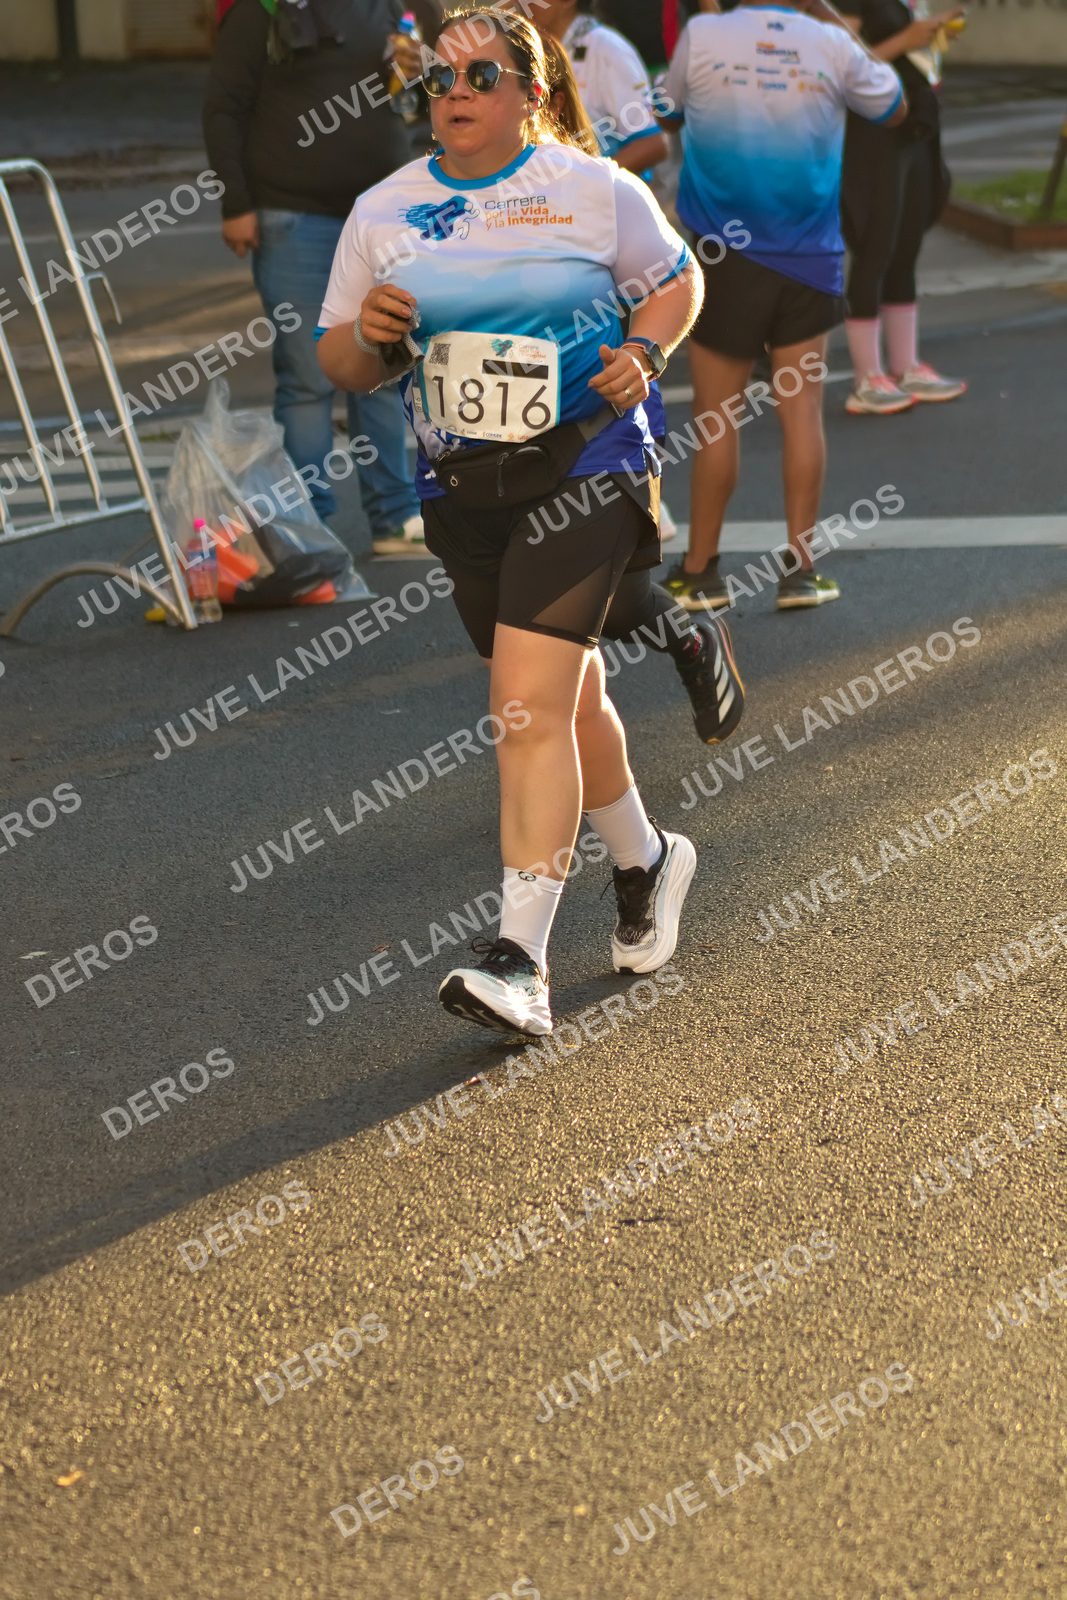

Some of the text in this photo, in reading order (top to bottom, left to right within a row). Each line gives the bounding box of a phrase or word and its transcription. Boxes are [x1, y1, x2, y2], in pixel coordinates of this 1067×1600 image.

[485, 195, 547, 210] Carrera
[521, 207, 549, 216] Vida
[485, 221, 492, 232] y
[508, 214, 573, 226] Integridad
[432, 376, 551, 430] 1816
